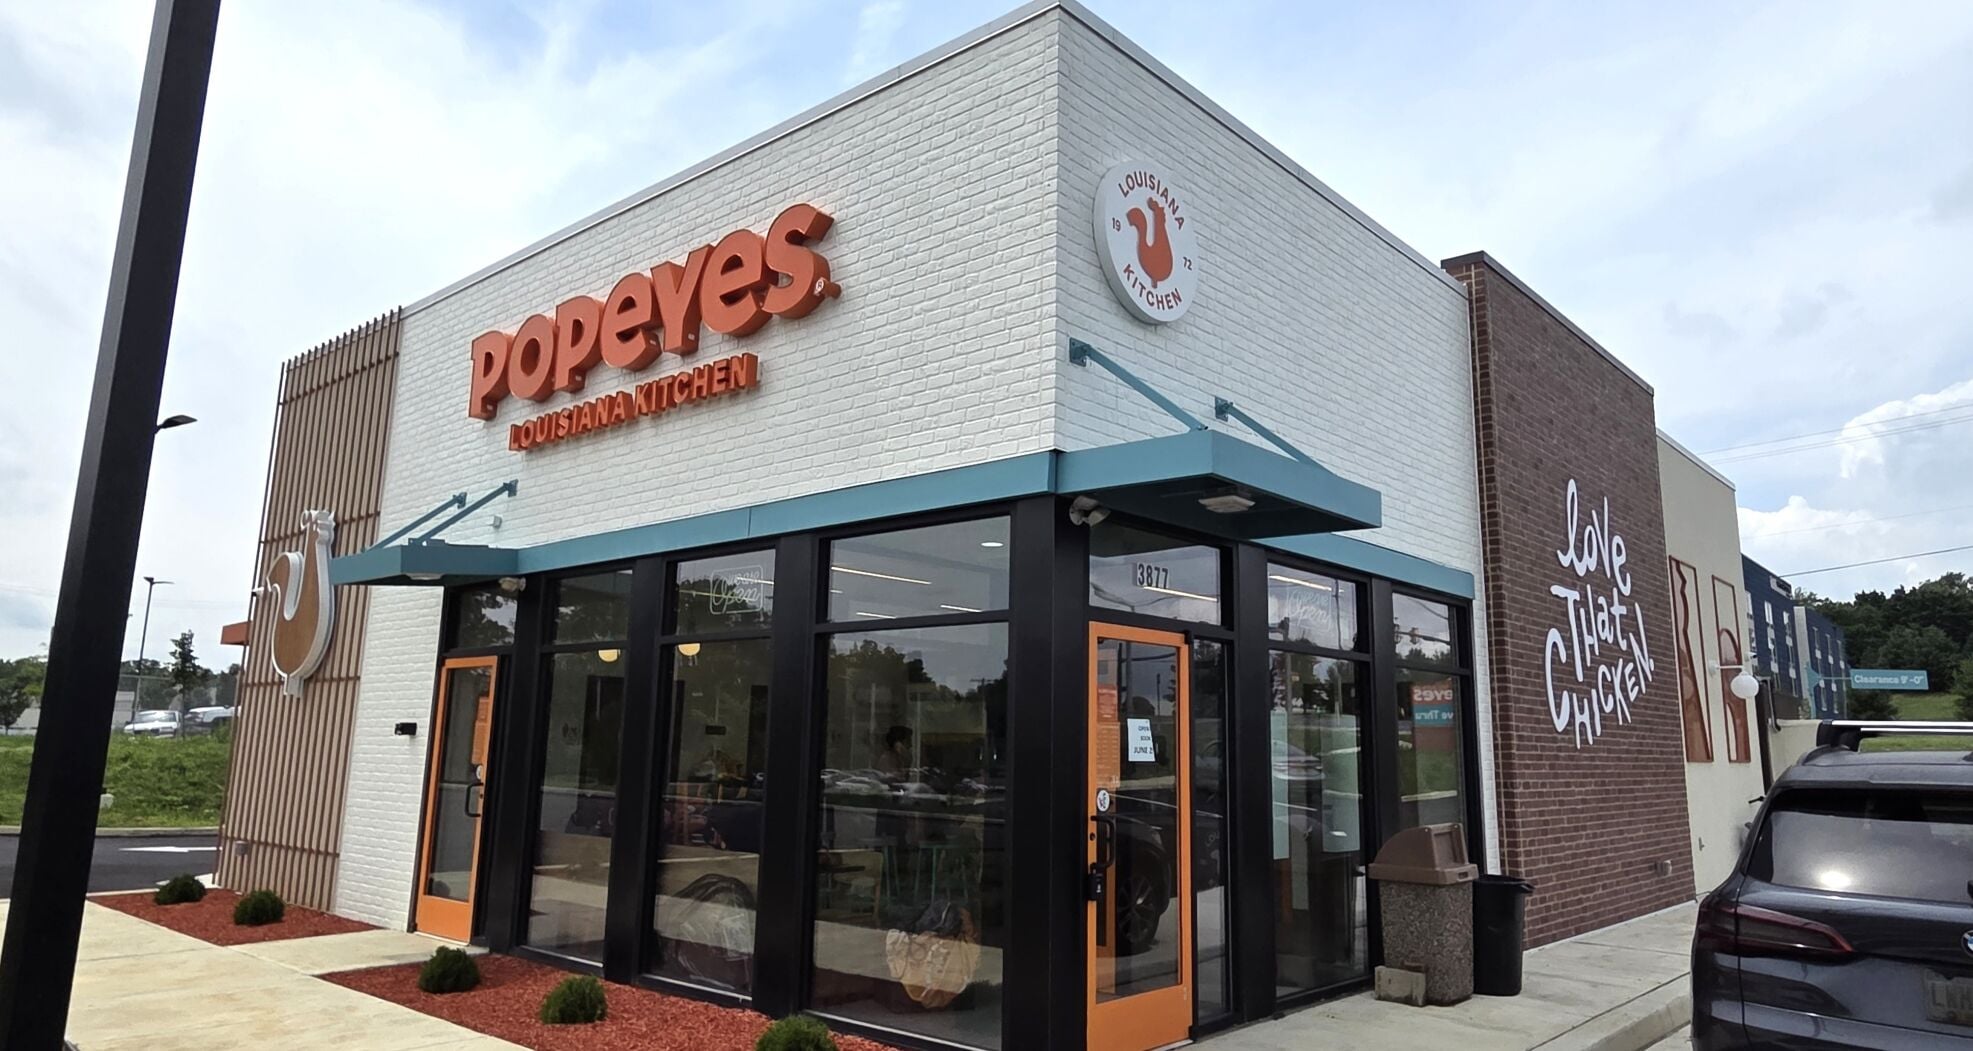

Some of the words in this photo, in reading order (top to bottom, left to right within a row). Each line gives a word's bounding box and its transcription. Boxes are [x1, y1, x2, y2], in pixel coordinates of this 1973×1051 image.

[1118, 171, 1185, 231] LOUISIANA
[1112, 217, 1121, 232] 19
[1183, 256, 1193, 271] 72
[1123, 263, 1183, 311] KITCHEN
[508, 390, 633, 451] LOUISIANA
[633, 353, 760, 417] KITCHEN
[1138, 563, 1169, 589] 3877
[1854, 674, 1899, 684] Clearance
